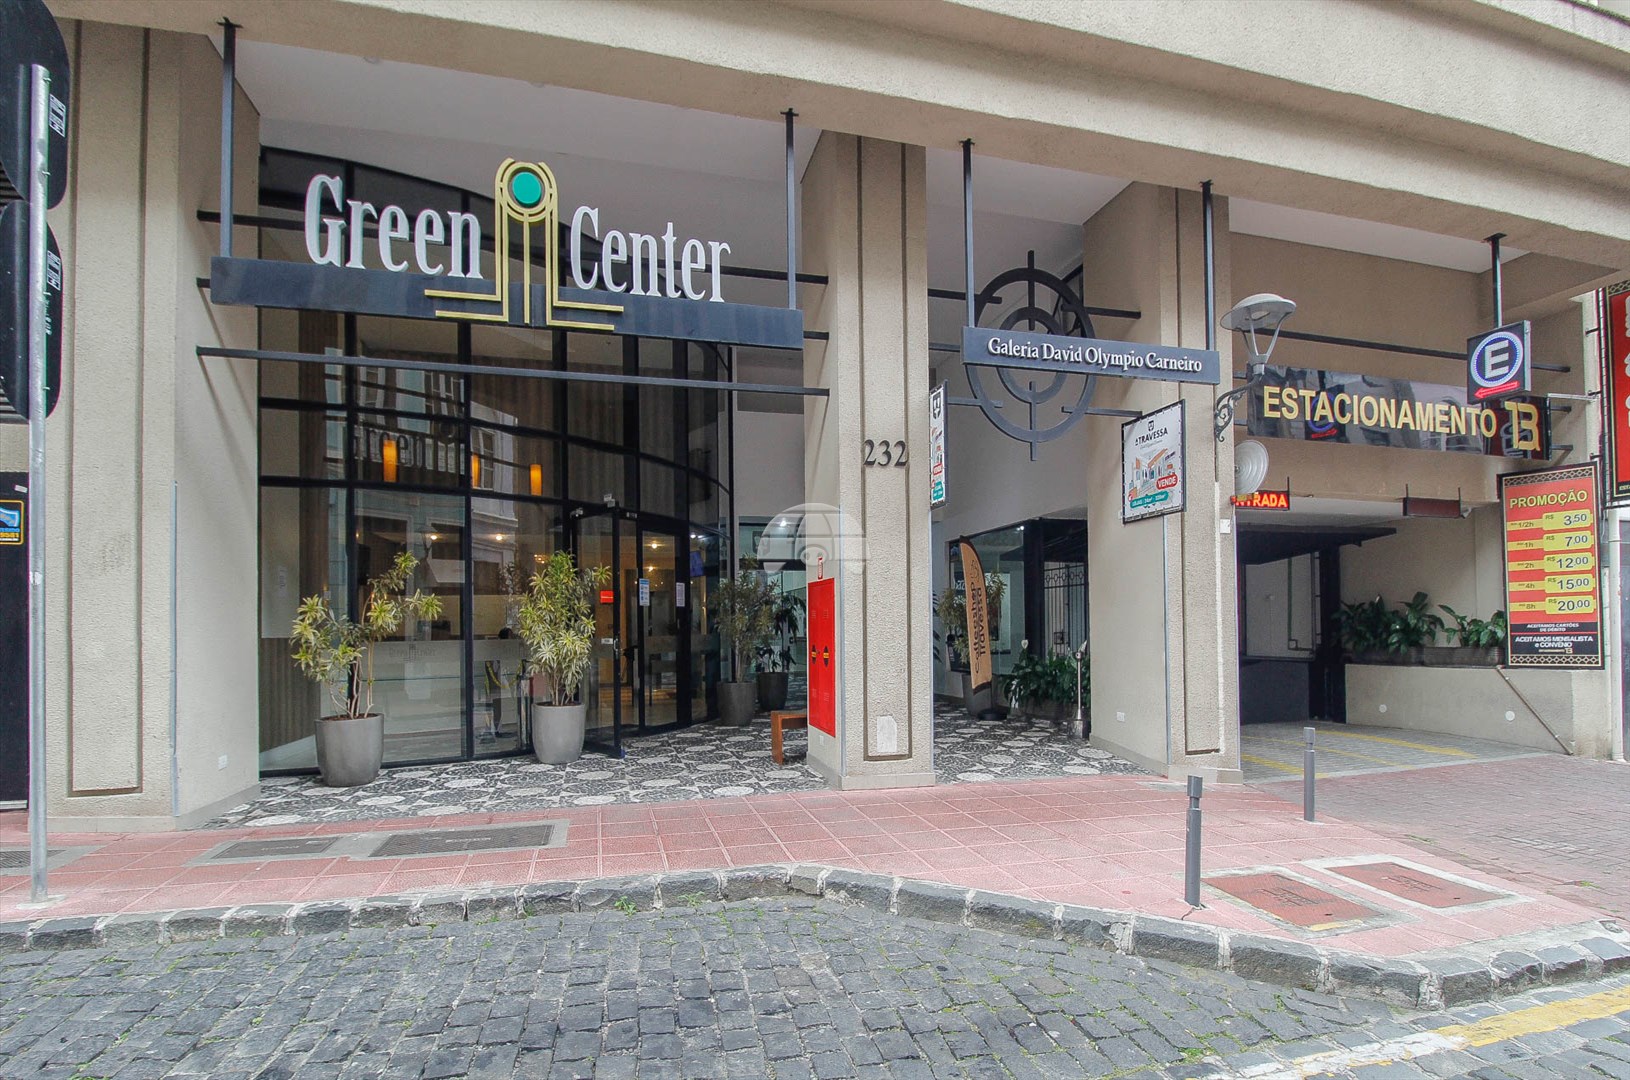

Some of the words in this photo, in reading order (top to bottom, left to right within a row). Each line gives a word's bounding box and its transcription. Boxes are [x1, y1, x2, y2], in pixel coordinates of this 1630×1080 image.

[304, 174, 484, 279] Green
[570, 206, 732, 303] Center
[987, 337, 1039, 359] Galeria
[1041, 342, 1083, 363] David
[1084, 345, 1144, 372] Olympio
[1145, 352, 1203, 373] Carneiro
[1485, 339, 1510, 379] E
[1263, 386, 1497, 438] ESTACIONAMENTO
[863, 439, 909, 467] 232
[1157, 475, 1178, 488] VENDE
[1509, 489, 1588, 509] PROMOÇÃO
